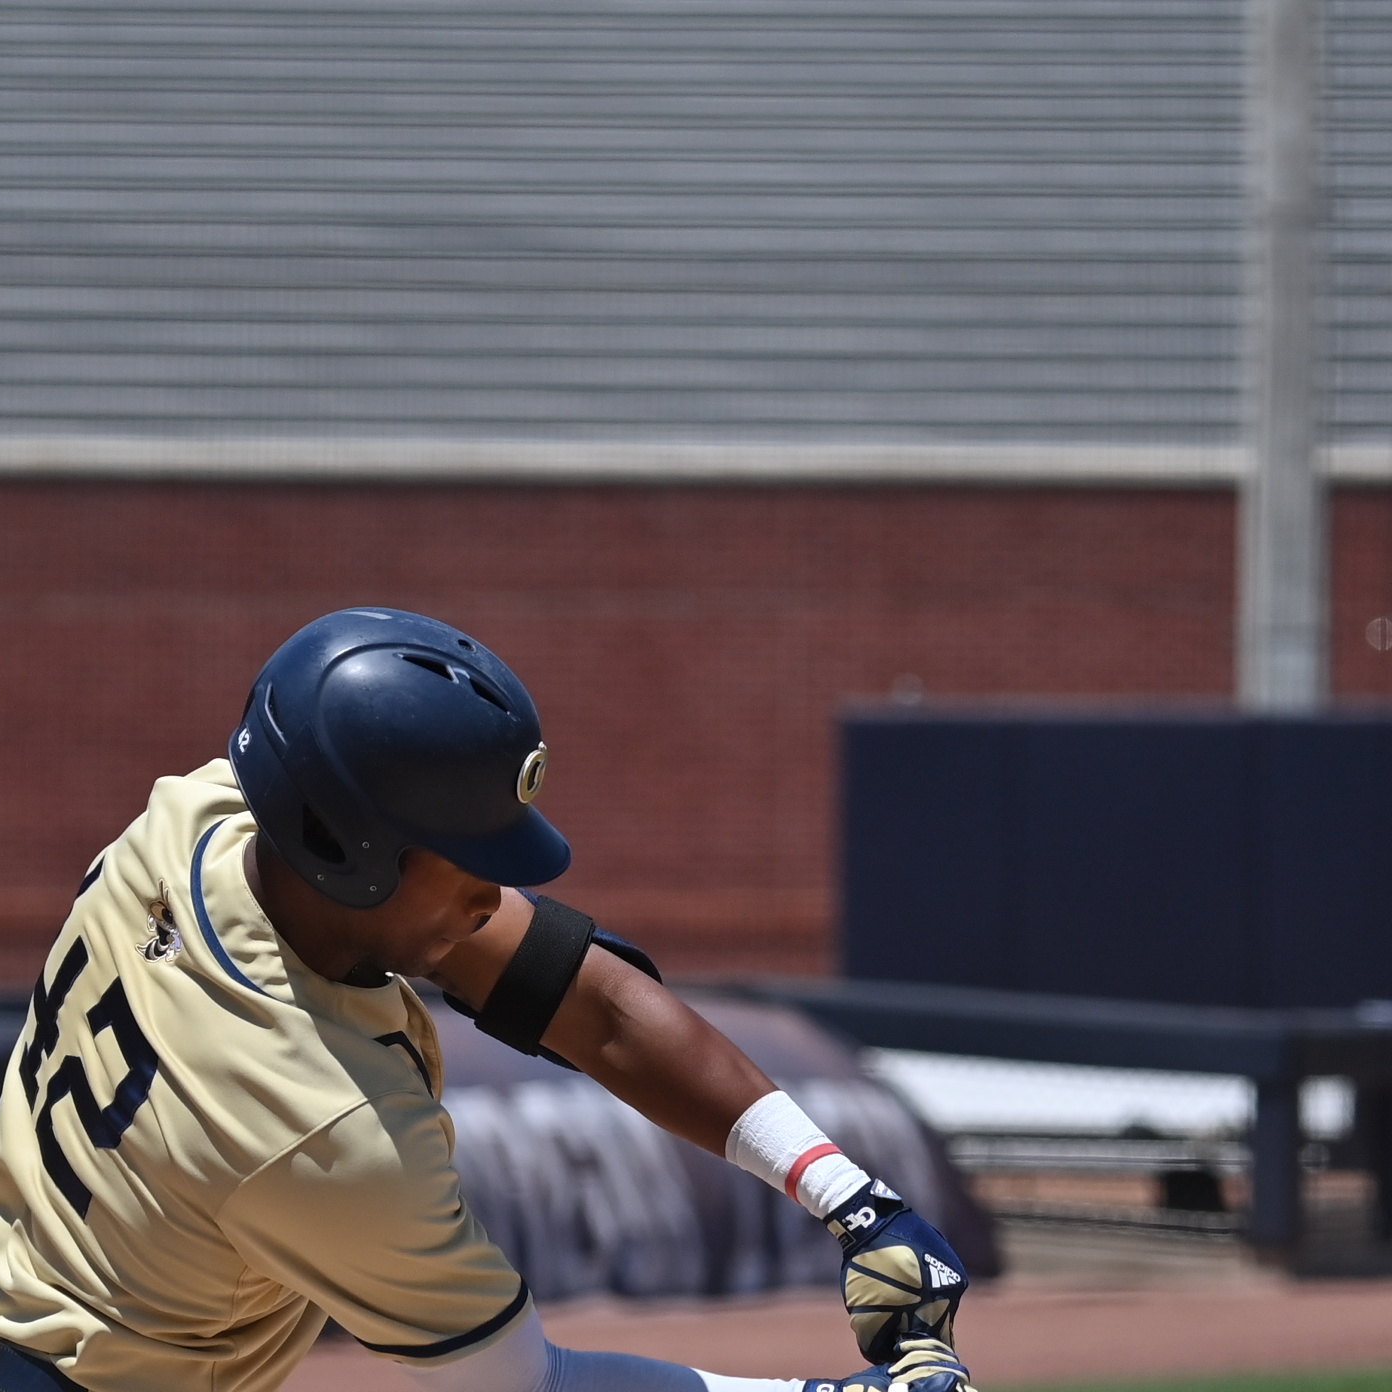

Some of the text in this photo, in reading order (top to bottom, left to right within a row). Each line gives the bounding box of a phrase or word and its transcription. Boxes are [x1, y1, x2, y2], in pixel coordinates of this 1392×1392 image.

[238, 727, 250, 754] 42
[18, 934, 160, 1222] 42
[924, 1253, 962, 1284] adidas
